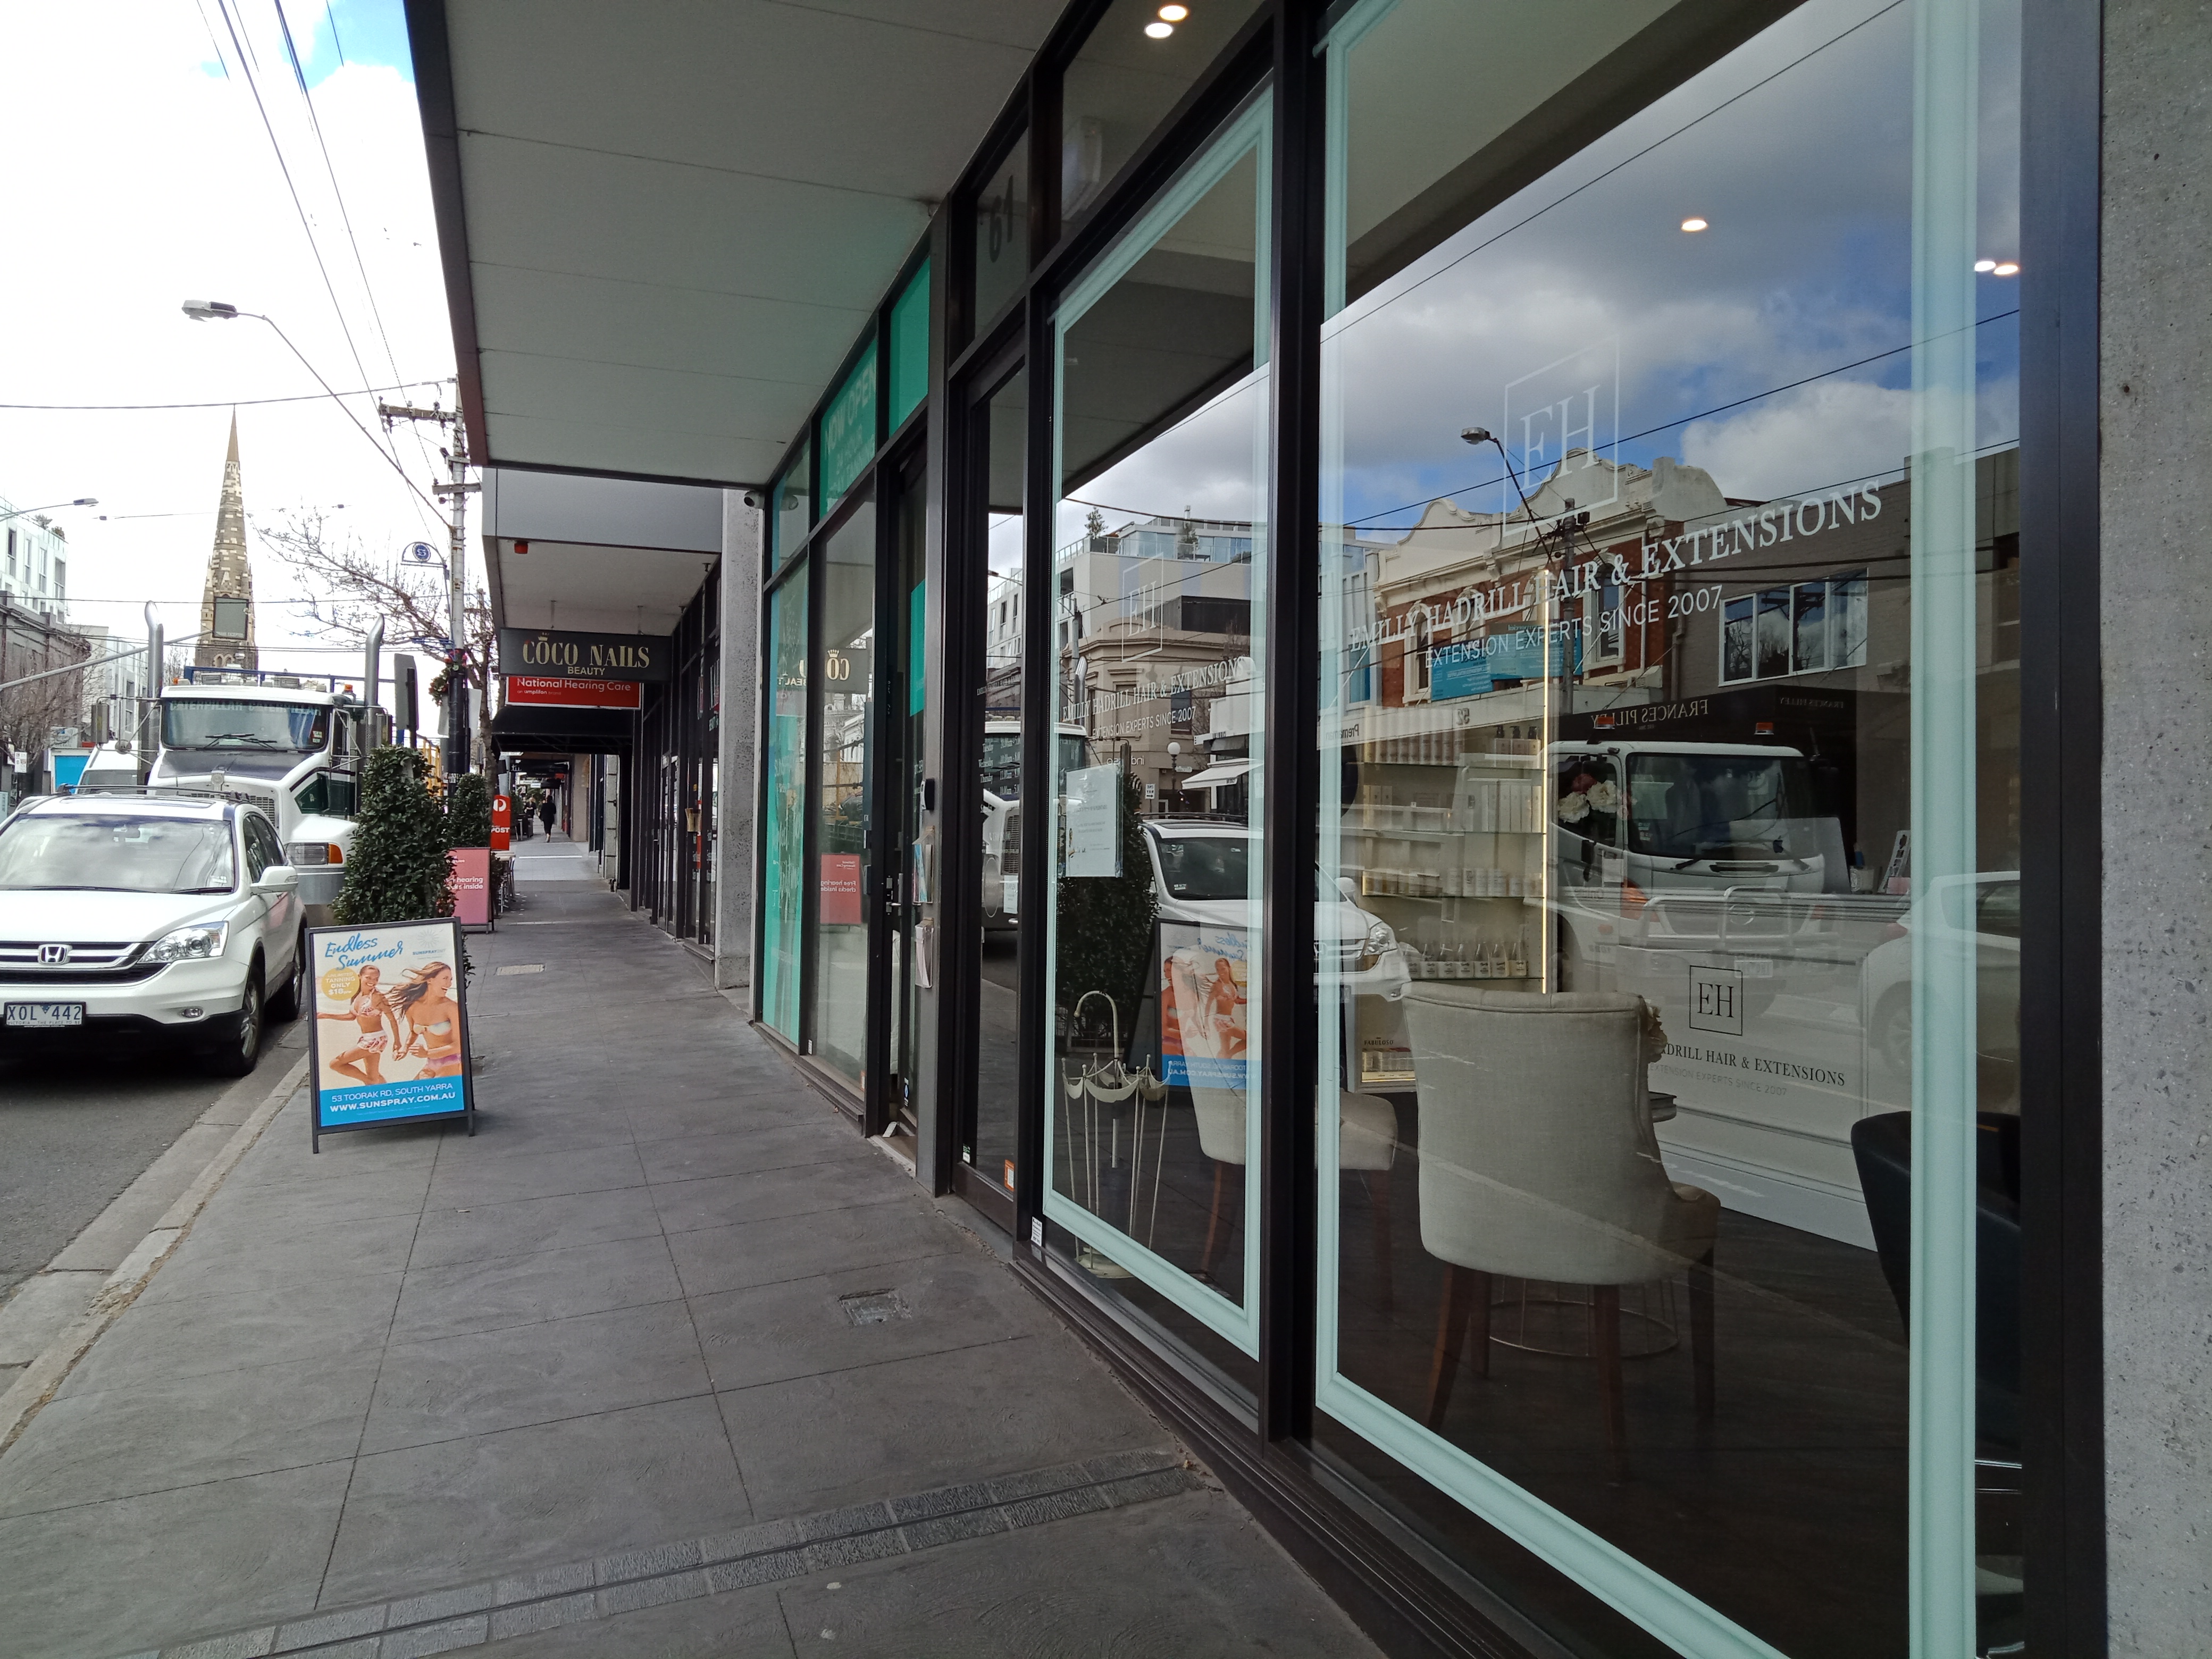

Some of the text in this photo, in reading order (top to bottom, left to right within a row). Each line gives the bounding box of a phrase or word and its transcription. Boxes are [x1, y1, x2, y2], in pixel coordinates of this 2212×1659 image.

[1519, 384, 1601, 491] EH
[1350, 480, 1882, 653] EMILLY HADRILL HAIR & EXTENSIONS
[1128, 581, 1157, 637] EH
[1426, 584, 1723, 668] EXTENSION EXPERTS SINCE 2007
[568, 666, 605, 675] BEAUTY
[590, 644, 650, 668] NAILS
[517, 677, 631, 692] National Hearing Care
[1062, 656, 1245, 722] EMILLY HADRILL HAIR & EXTENSIONS
[1092, 706, 1196, 739] EXTENSION EXPERTS SINCE 2007
[325, 933, 378, 958] Endless
[336, 941, 403, 971] Summer
[7, 1006, 81, 1020] XOL 442
[1697, 982, 1735, 1018] EH
[1706, 1050, 1737, 1067] HAIR
[1741, 1057, 1749, 1069] &
[1755, 1058, 1845, 1086] EXTENSIONS
[344, 1091, 379, 1101] TOORAK
[395, 1087, 424, 1095] SOUTH
[425, 1083, 453, 1091] YARRA
[1696, 1071, 1733, 1086] EXPERTS
[1736, 1078, 1762, 1092] SINCE
[1765, 1085, 1787, 1096] 2007
[330, 1092, 456, 1112] WWW.SUNSPRAY.COM.AU
